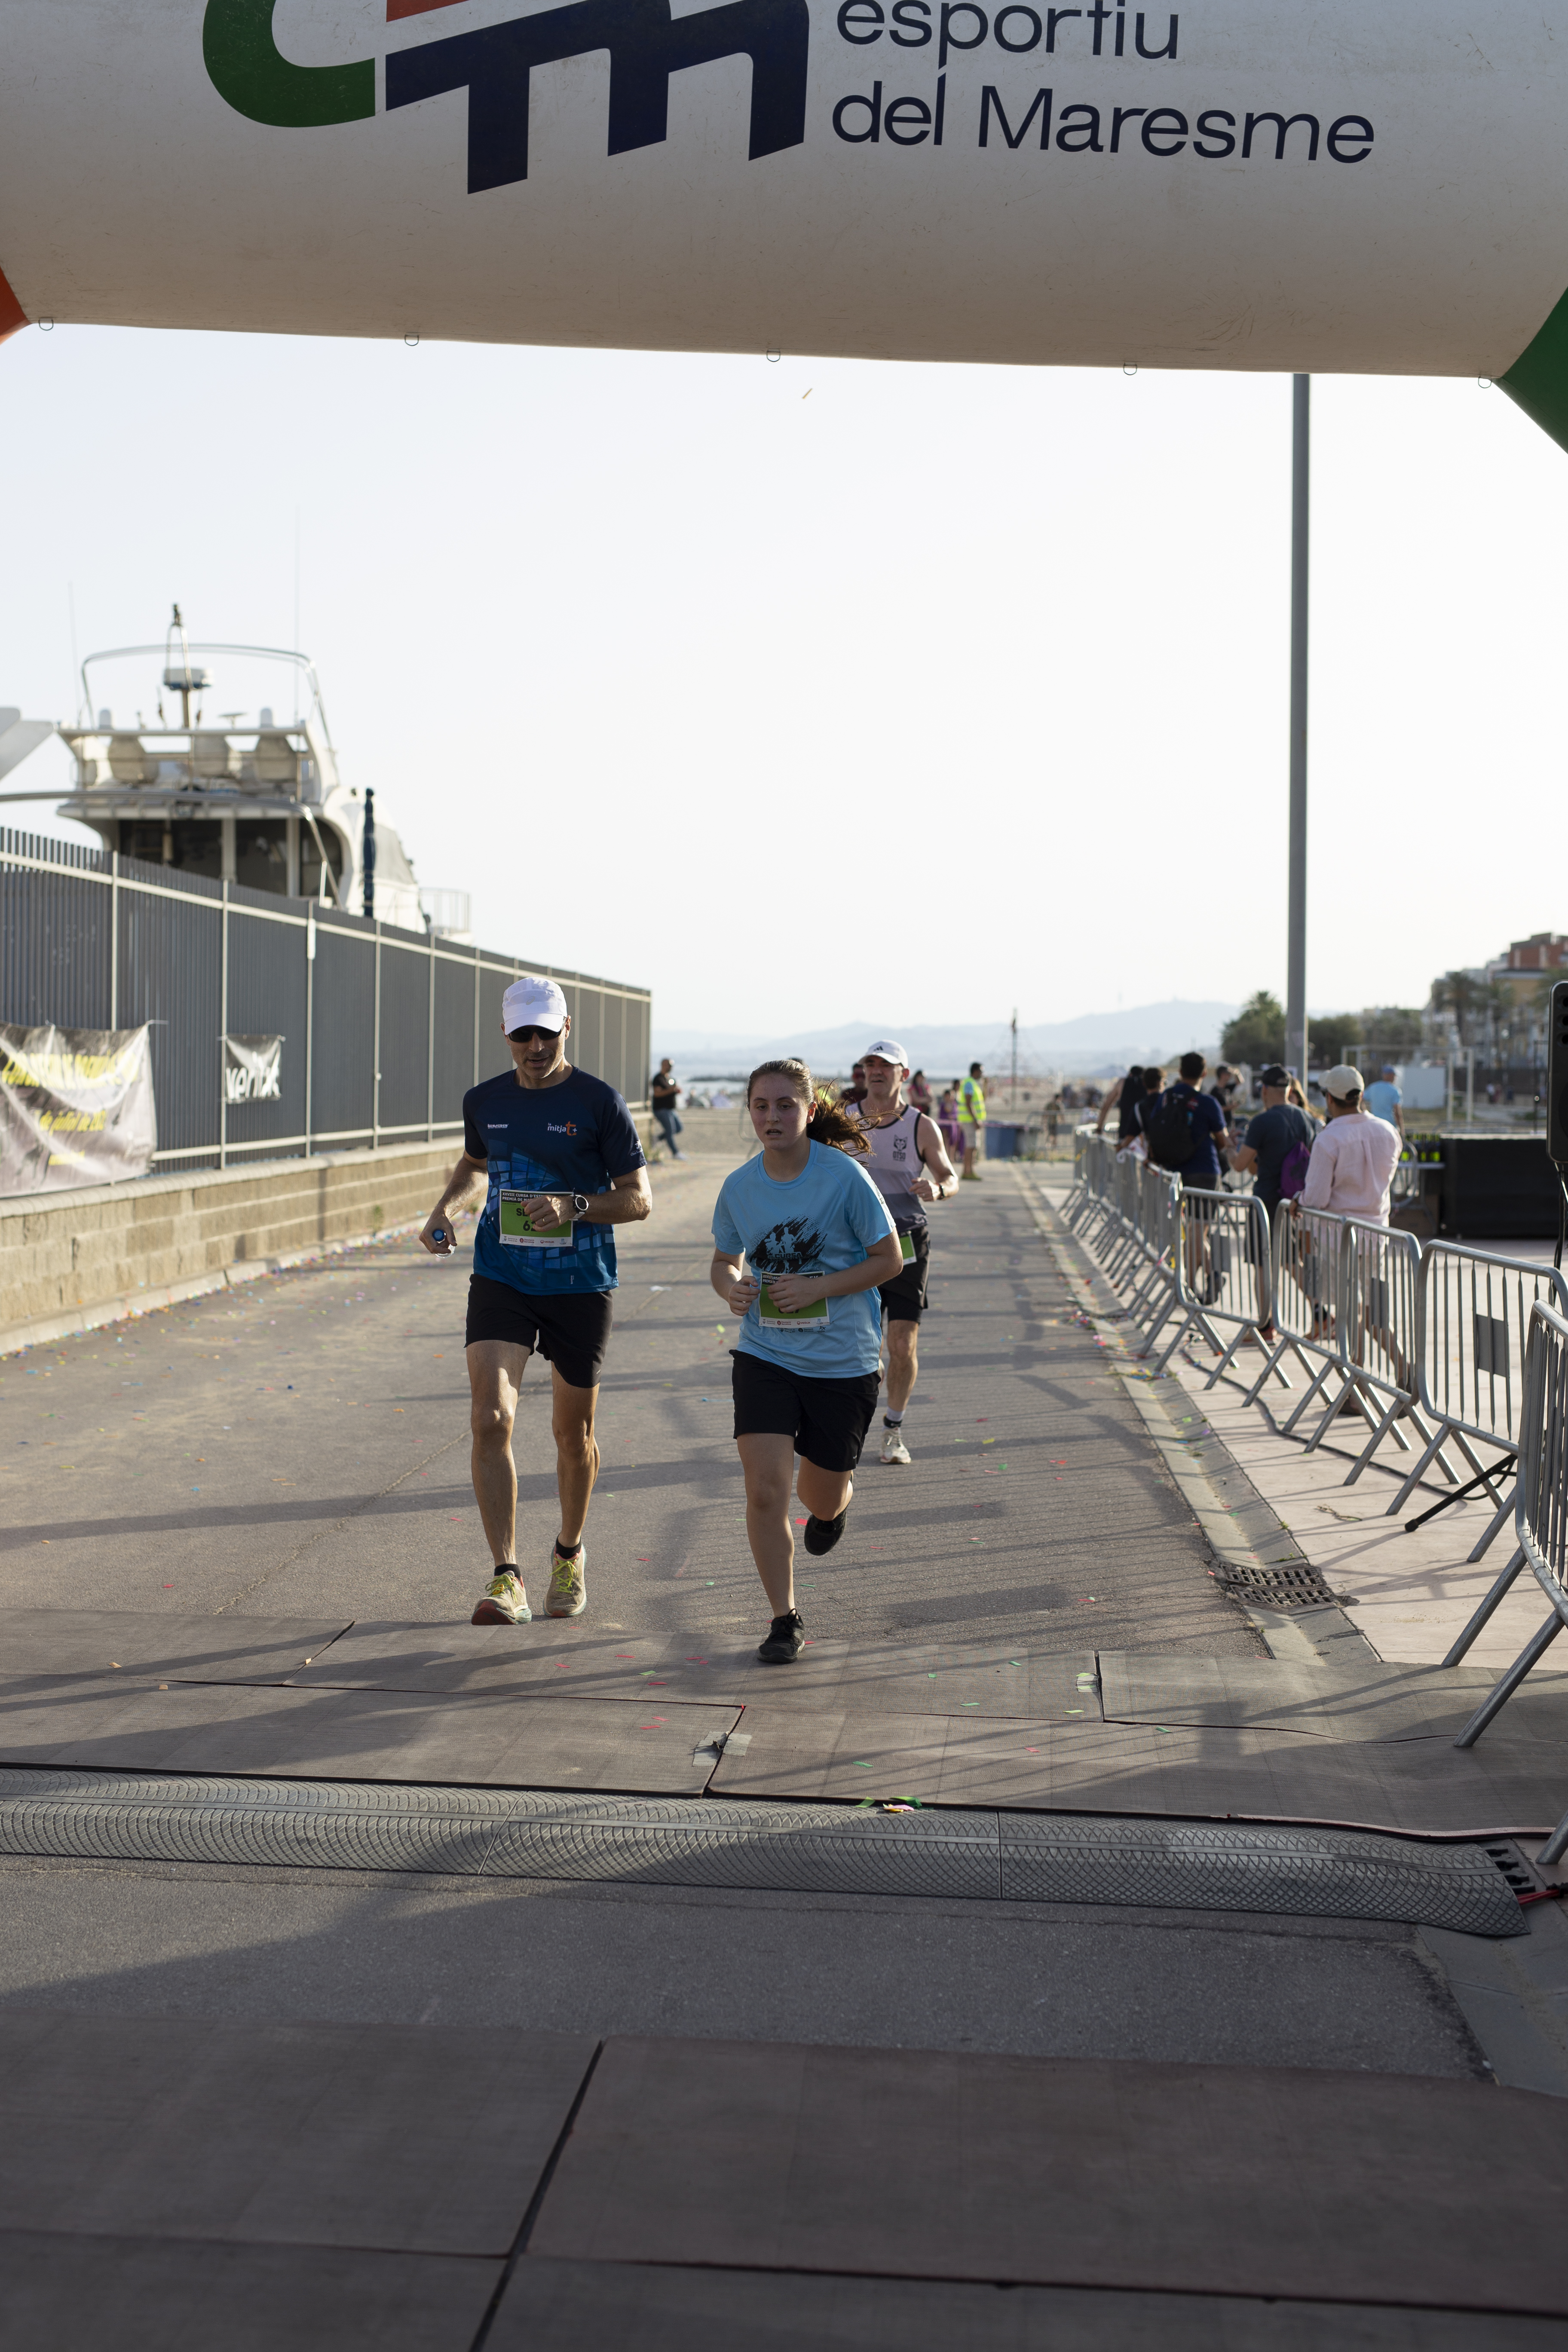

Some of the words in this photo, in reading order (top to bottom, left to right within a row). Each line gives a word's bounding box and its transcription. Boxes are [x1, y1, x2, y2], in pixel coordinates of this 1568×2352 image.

[832, 72, 946, 146] del
[978, 85, 1375, 164] Maresme
[547, 1125, 567, 1133] mitja
